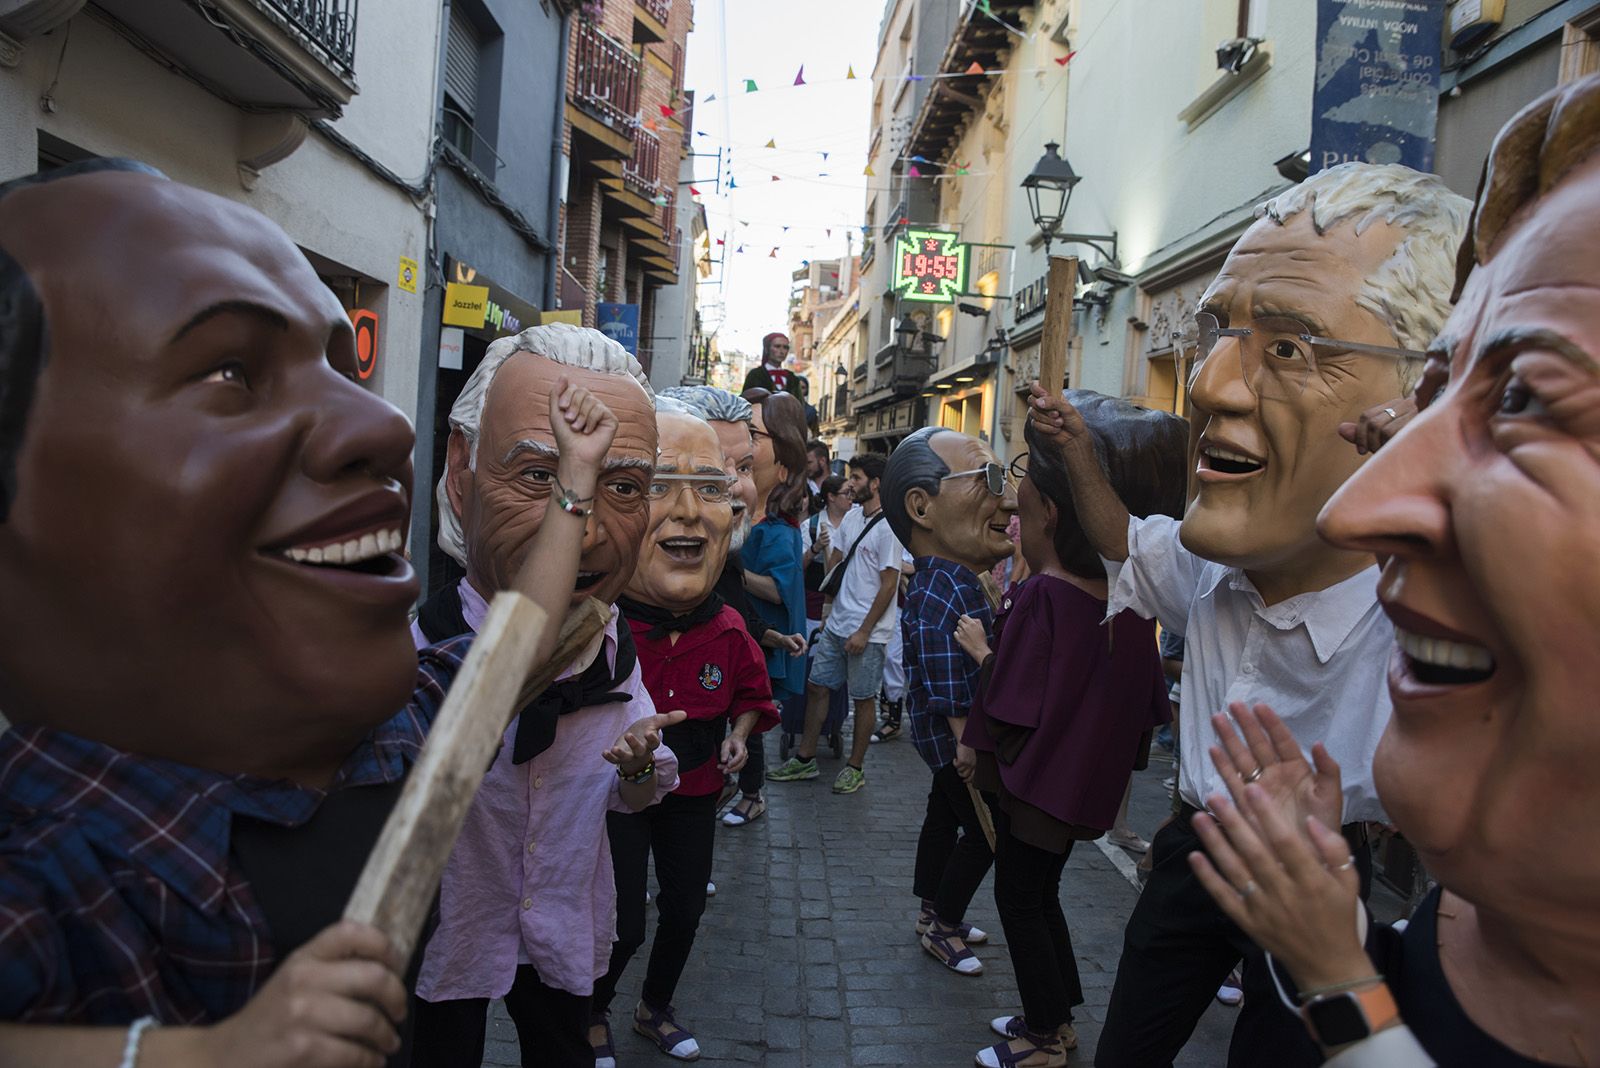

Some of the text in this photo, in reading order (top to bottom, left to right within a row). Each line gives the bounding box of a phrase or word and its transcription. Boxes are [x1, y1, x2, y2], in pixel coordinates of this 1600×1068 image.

[1339, 16, 1418, 34] MODA INTIMA
[1413, 55, 1433, 69] de
[903, 253, 958, 280] 19:55
[453, 300, 482, 311] Jazztel
